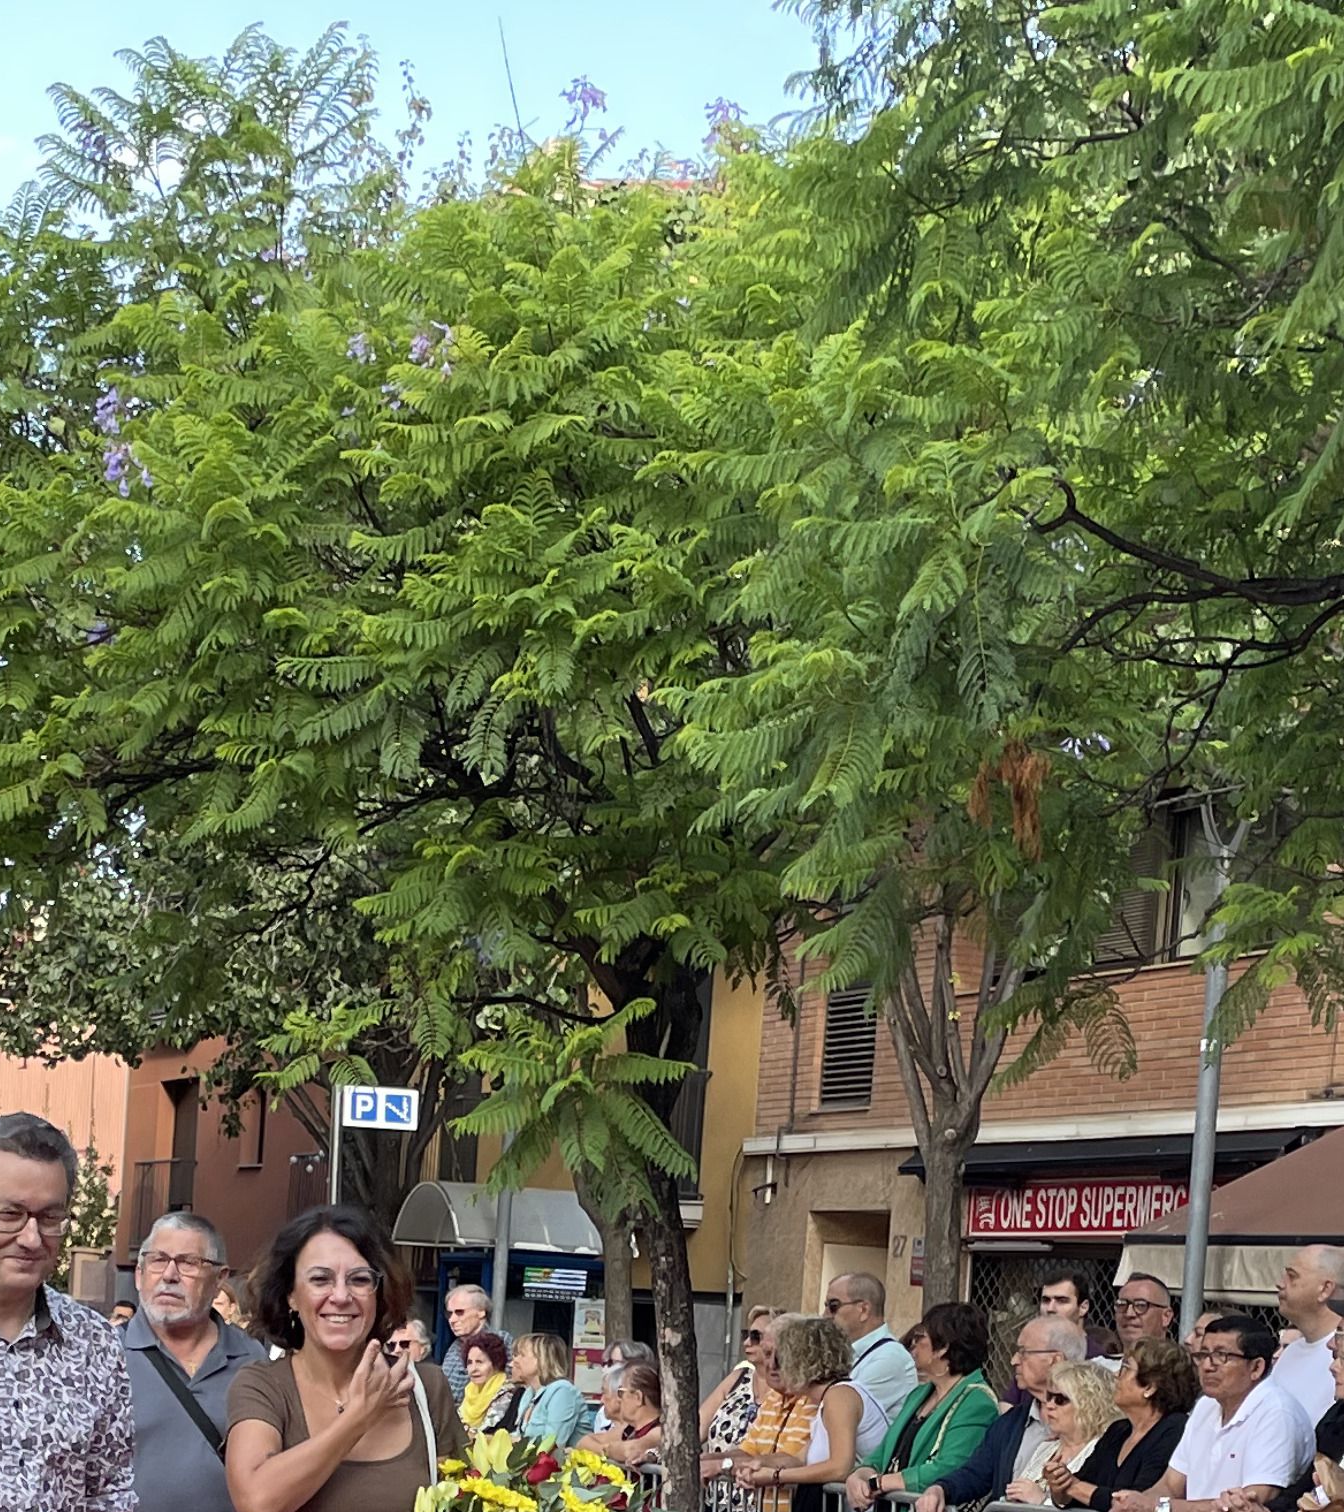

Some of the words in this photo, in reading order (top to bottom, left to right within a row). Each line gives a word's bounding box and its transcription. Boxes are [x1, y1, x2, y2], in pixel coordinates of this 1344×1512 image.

[356, 1094, 374, 1119] P
[1000, 1189, 1033, 1229] ONE
[1035, 1187, 1077, 1229] STOP
[893, 1235, 907, 1258] 27
